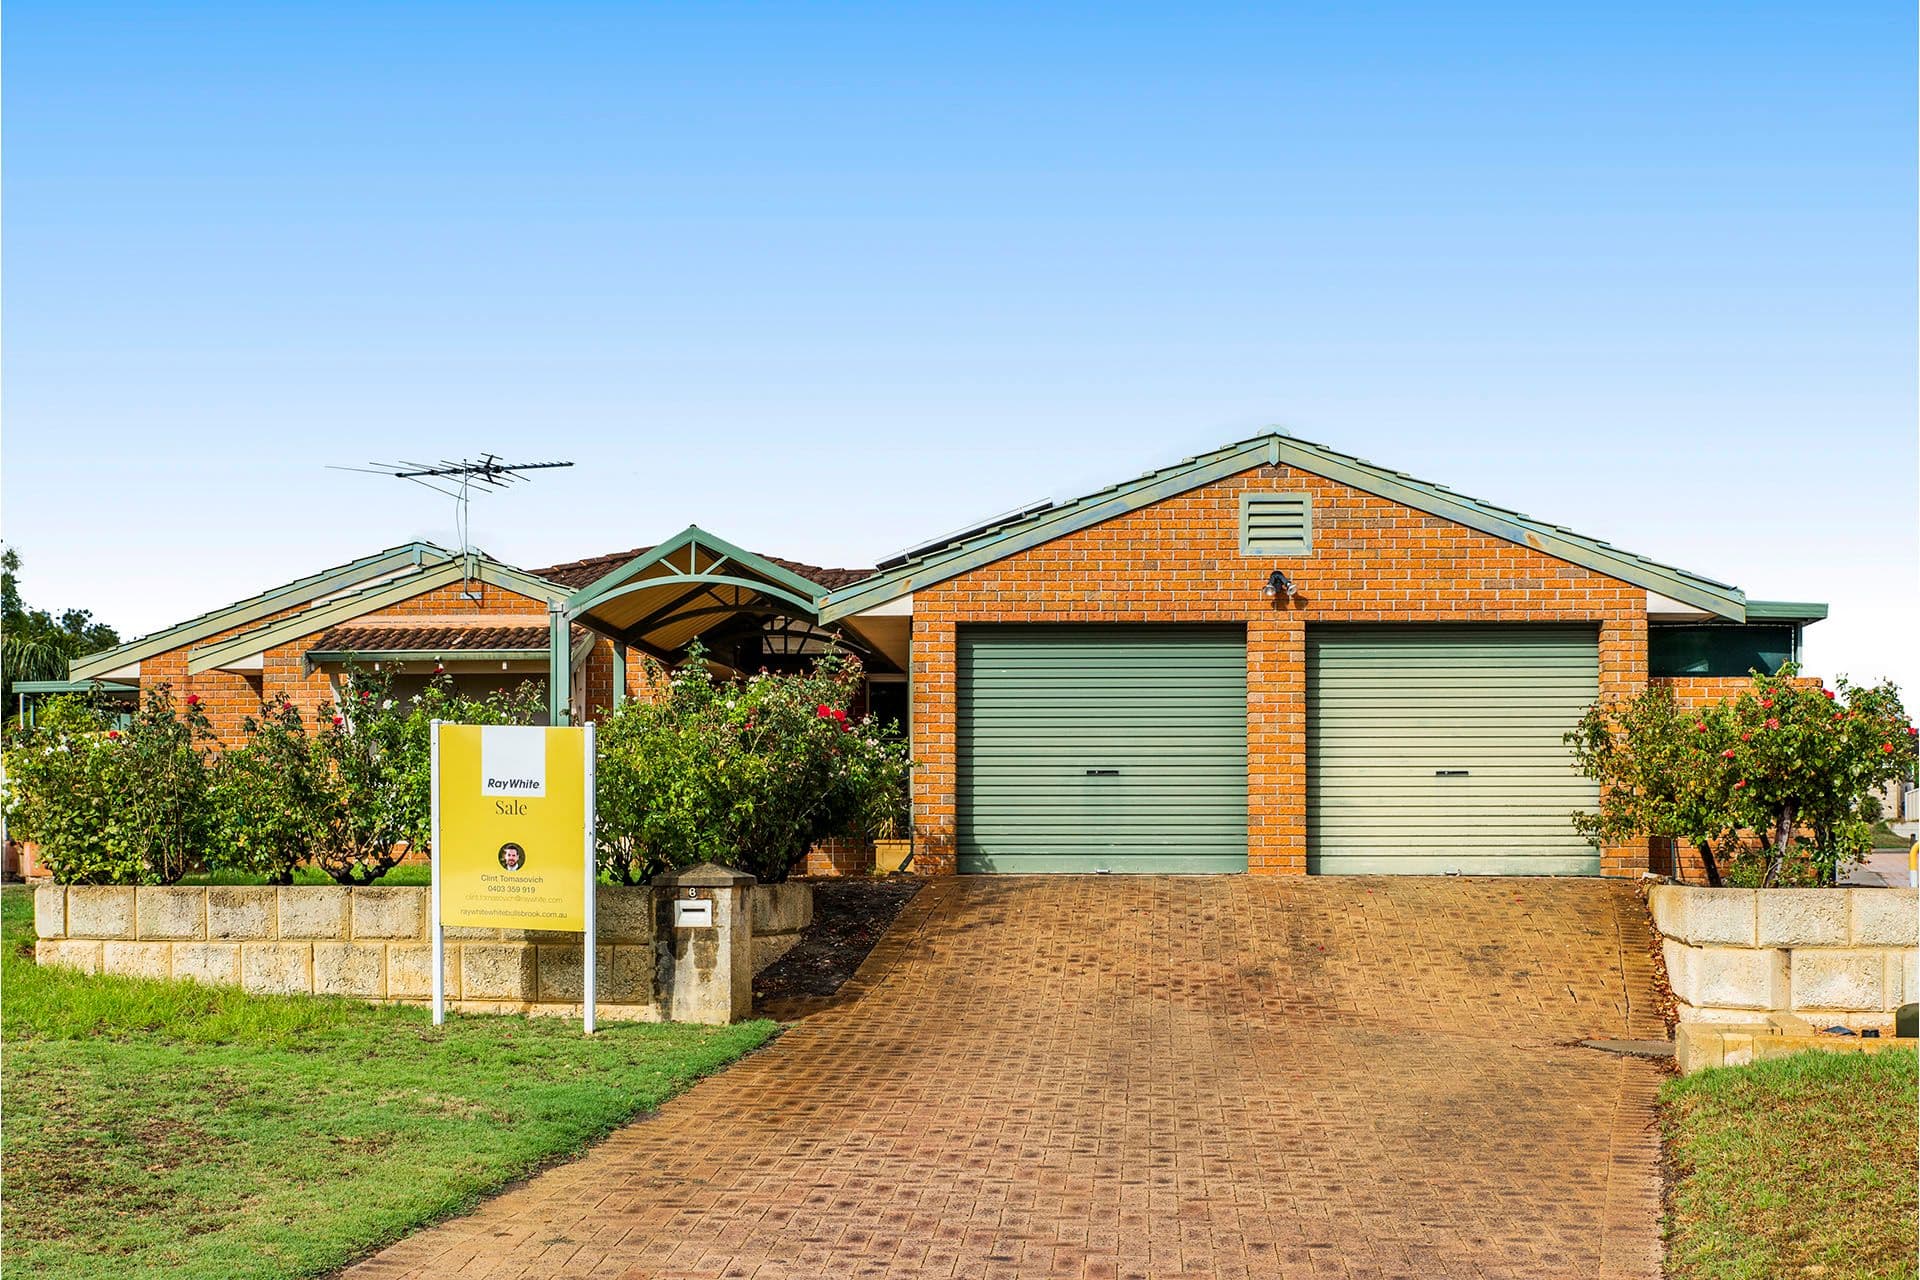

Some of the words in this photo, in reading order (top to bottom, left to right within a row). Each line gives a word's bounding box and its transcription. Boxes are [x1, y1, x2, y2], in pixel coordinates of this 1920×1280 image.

[495, 799, 528, 816] Sale
[480, 874, 498, 882] Clint
[500, 874, 544, 884] Tomasovich
[488, 885, 505, 893] 0403
[507, 885, 521, 893] 359
